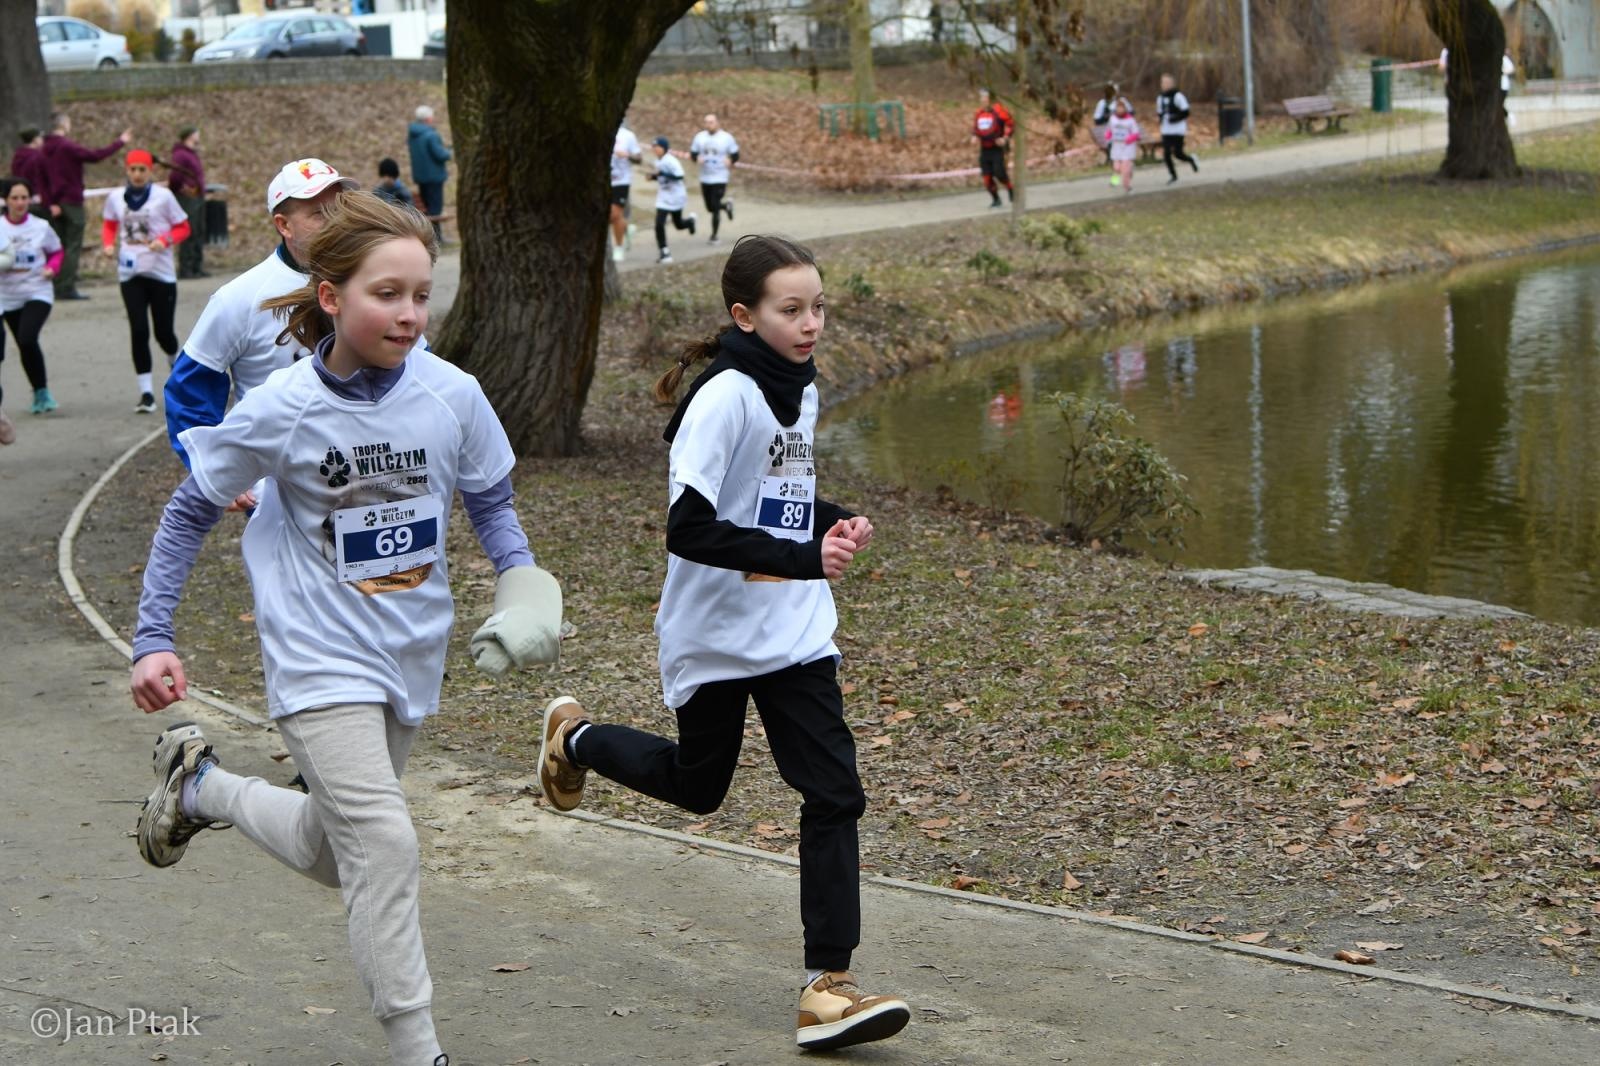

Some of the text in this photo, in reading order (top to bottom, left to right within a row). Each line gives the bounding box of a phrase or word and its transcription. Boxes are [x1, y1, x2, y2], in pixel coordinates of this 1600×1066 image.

[352, 442, 391, 457] TROPEM
[355, 448, 427, 476] WILCZYM
[375, 478, 405, 490] EDYCJA
[381, 509, 416, 523] WILCZYM
[781, 502, 804, 528] 89
[375, 526, 413, 556] 69
